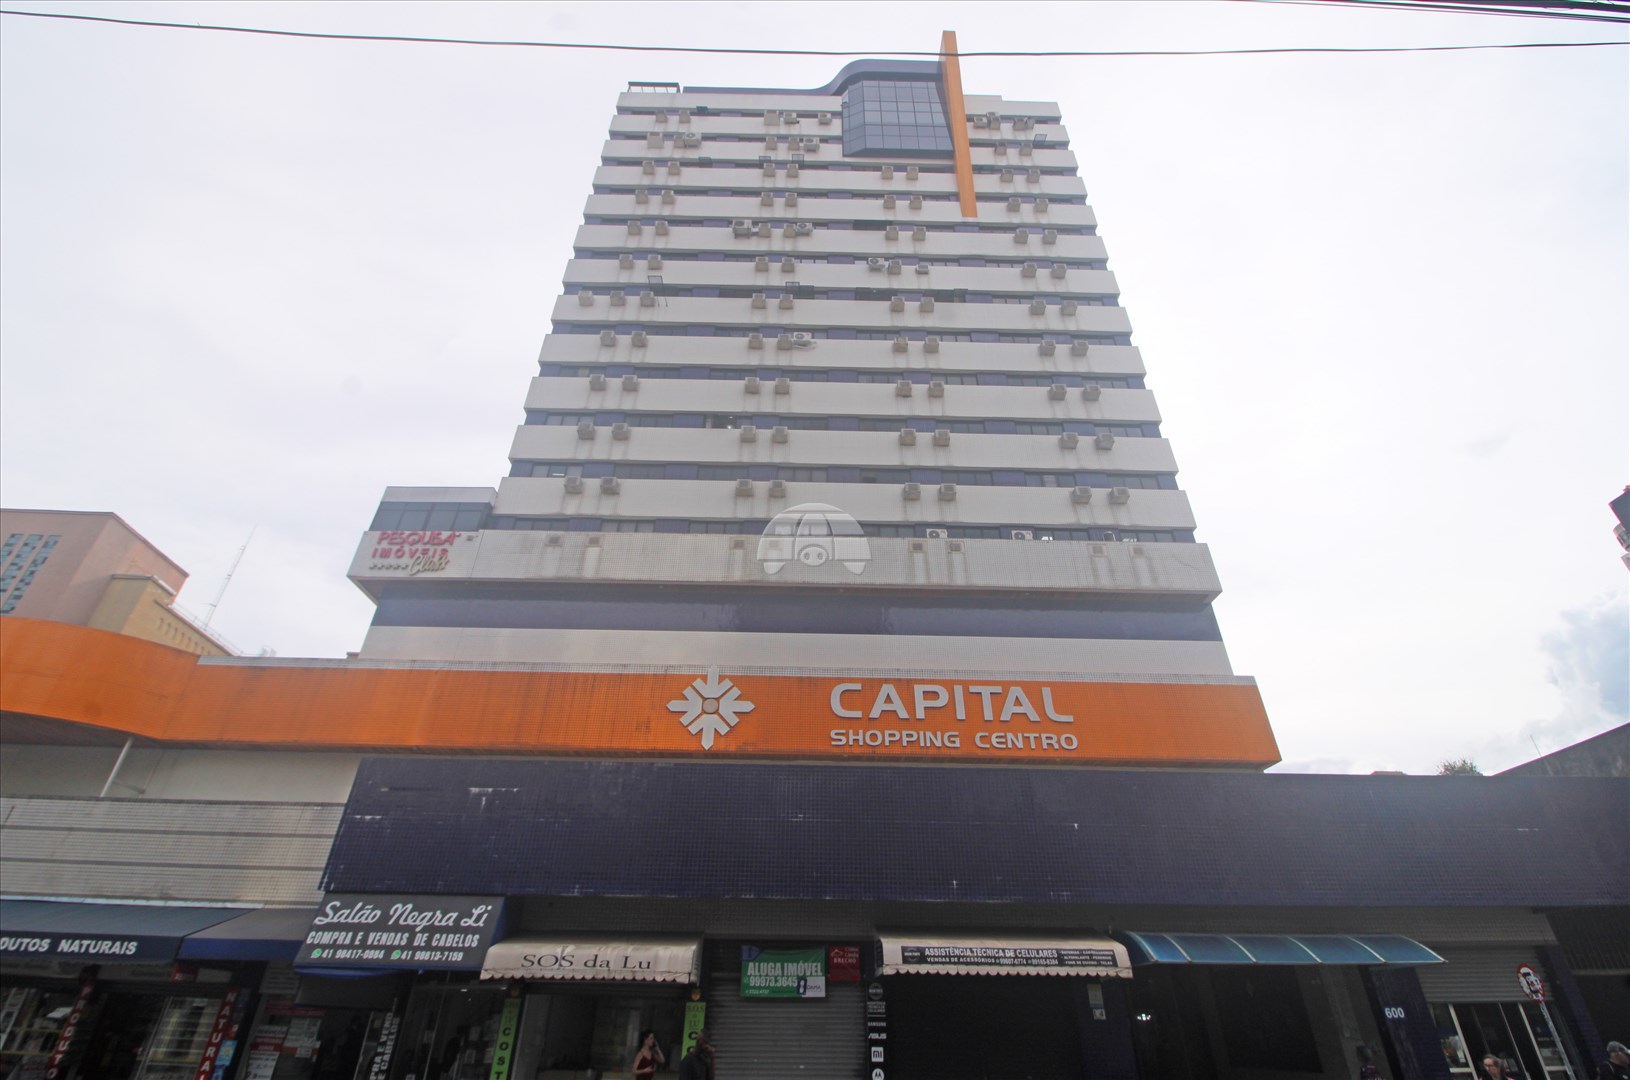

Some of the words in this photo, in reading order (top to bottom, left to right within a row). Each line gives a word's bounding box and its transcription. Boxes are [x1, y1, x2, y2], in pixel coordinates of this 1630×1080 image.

[830, 682, 1075, 723] CAPITAL
[829, 729, 961, 748] SHOPPING
[974, 731, 1079, 750] CENTRO
[313, 901, 382, 926] Salão
[388, 903, 459, 932] Negra
[460, 905, 493, 927] Li
[57, 938, 139, 955] NATURAIS
[306, 931, 353, 945] COMPRA
[354, 932, 364, 945] E
[366, 932, 409, 946] VENDAS
[413, 933, 428, 947] DE
[431, 933, 480, 948] CABELOS
[321, 949, 334, 959] 41
[400, 950, 413, 960] 41
[924, 946, 972, 957] ASSISTÊNCIA
[972, 947, 1004, 958] TÉCNICA
[1004, 949, 1015, 958] DE
[1016, 949, 1058, 958] CELULARES
[521, 954, 575, 968] SOS
[583, 954, 610, 969] da
[622, 955, 651, 969] Lu
[747, 963, 782, 975] ALUGA
[784, 960, 822, 976] IMÓVEL
[1384, 1007, 1405, 1018] 600
[494, 1026, 512, 1080] COST
